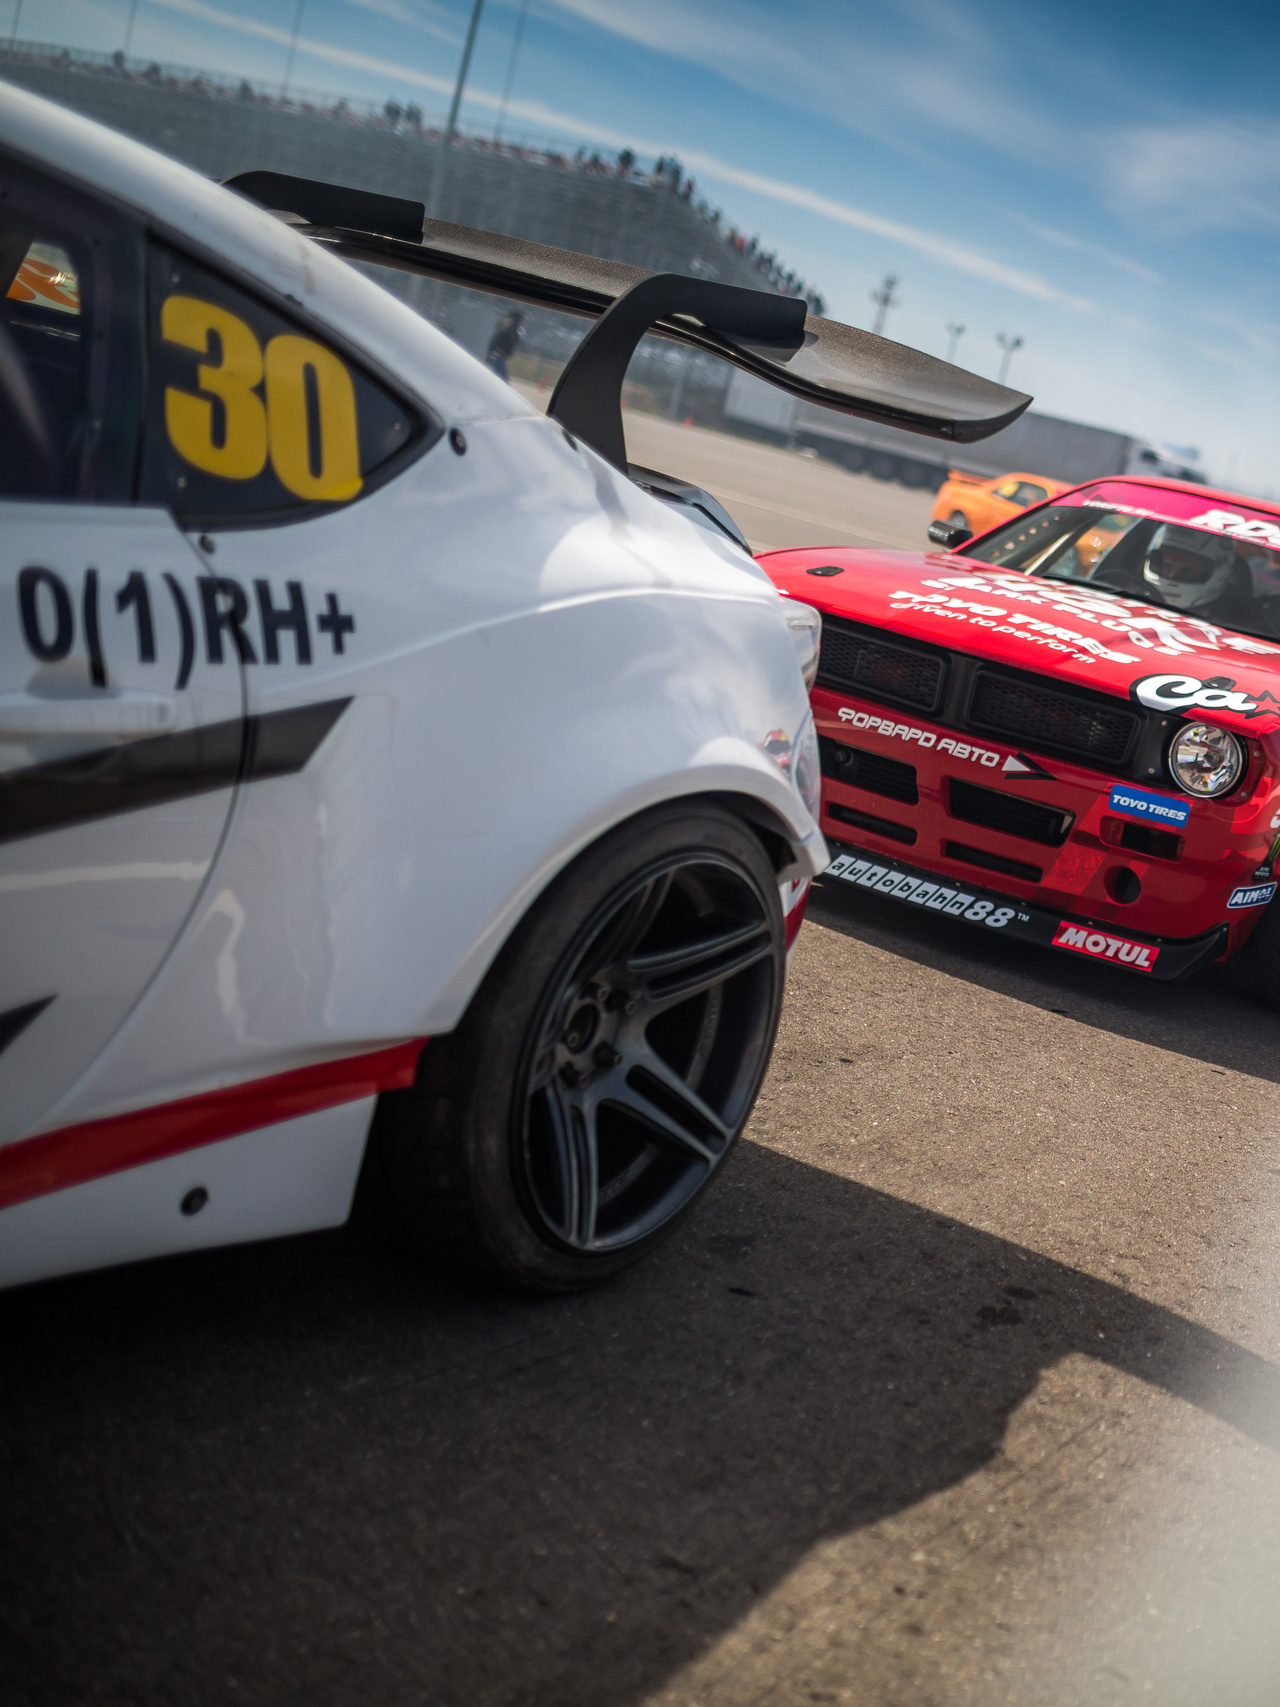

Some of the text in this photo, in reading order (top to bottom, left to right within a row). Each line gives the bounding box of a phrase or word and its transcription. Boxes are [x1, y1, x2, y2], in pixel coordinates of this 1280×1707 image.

[160, 295, 363, 501] 30
[888, 590, 1008, 617] TOYO
[1007, 612, 1141, 664] TIRES
[889, 601, 1097, 664] driven to perform
[1112, 793, 1187, 821] TOYO TIRES
[1058, 927, 1152, 968] MOTUL
